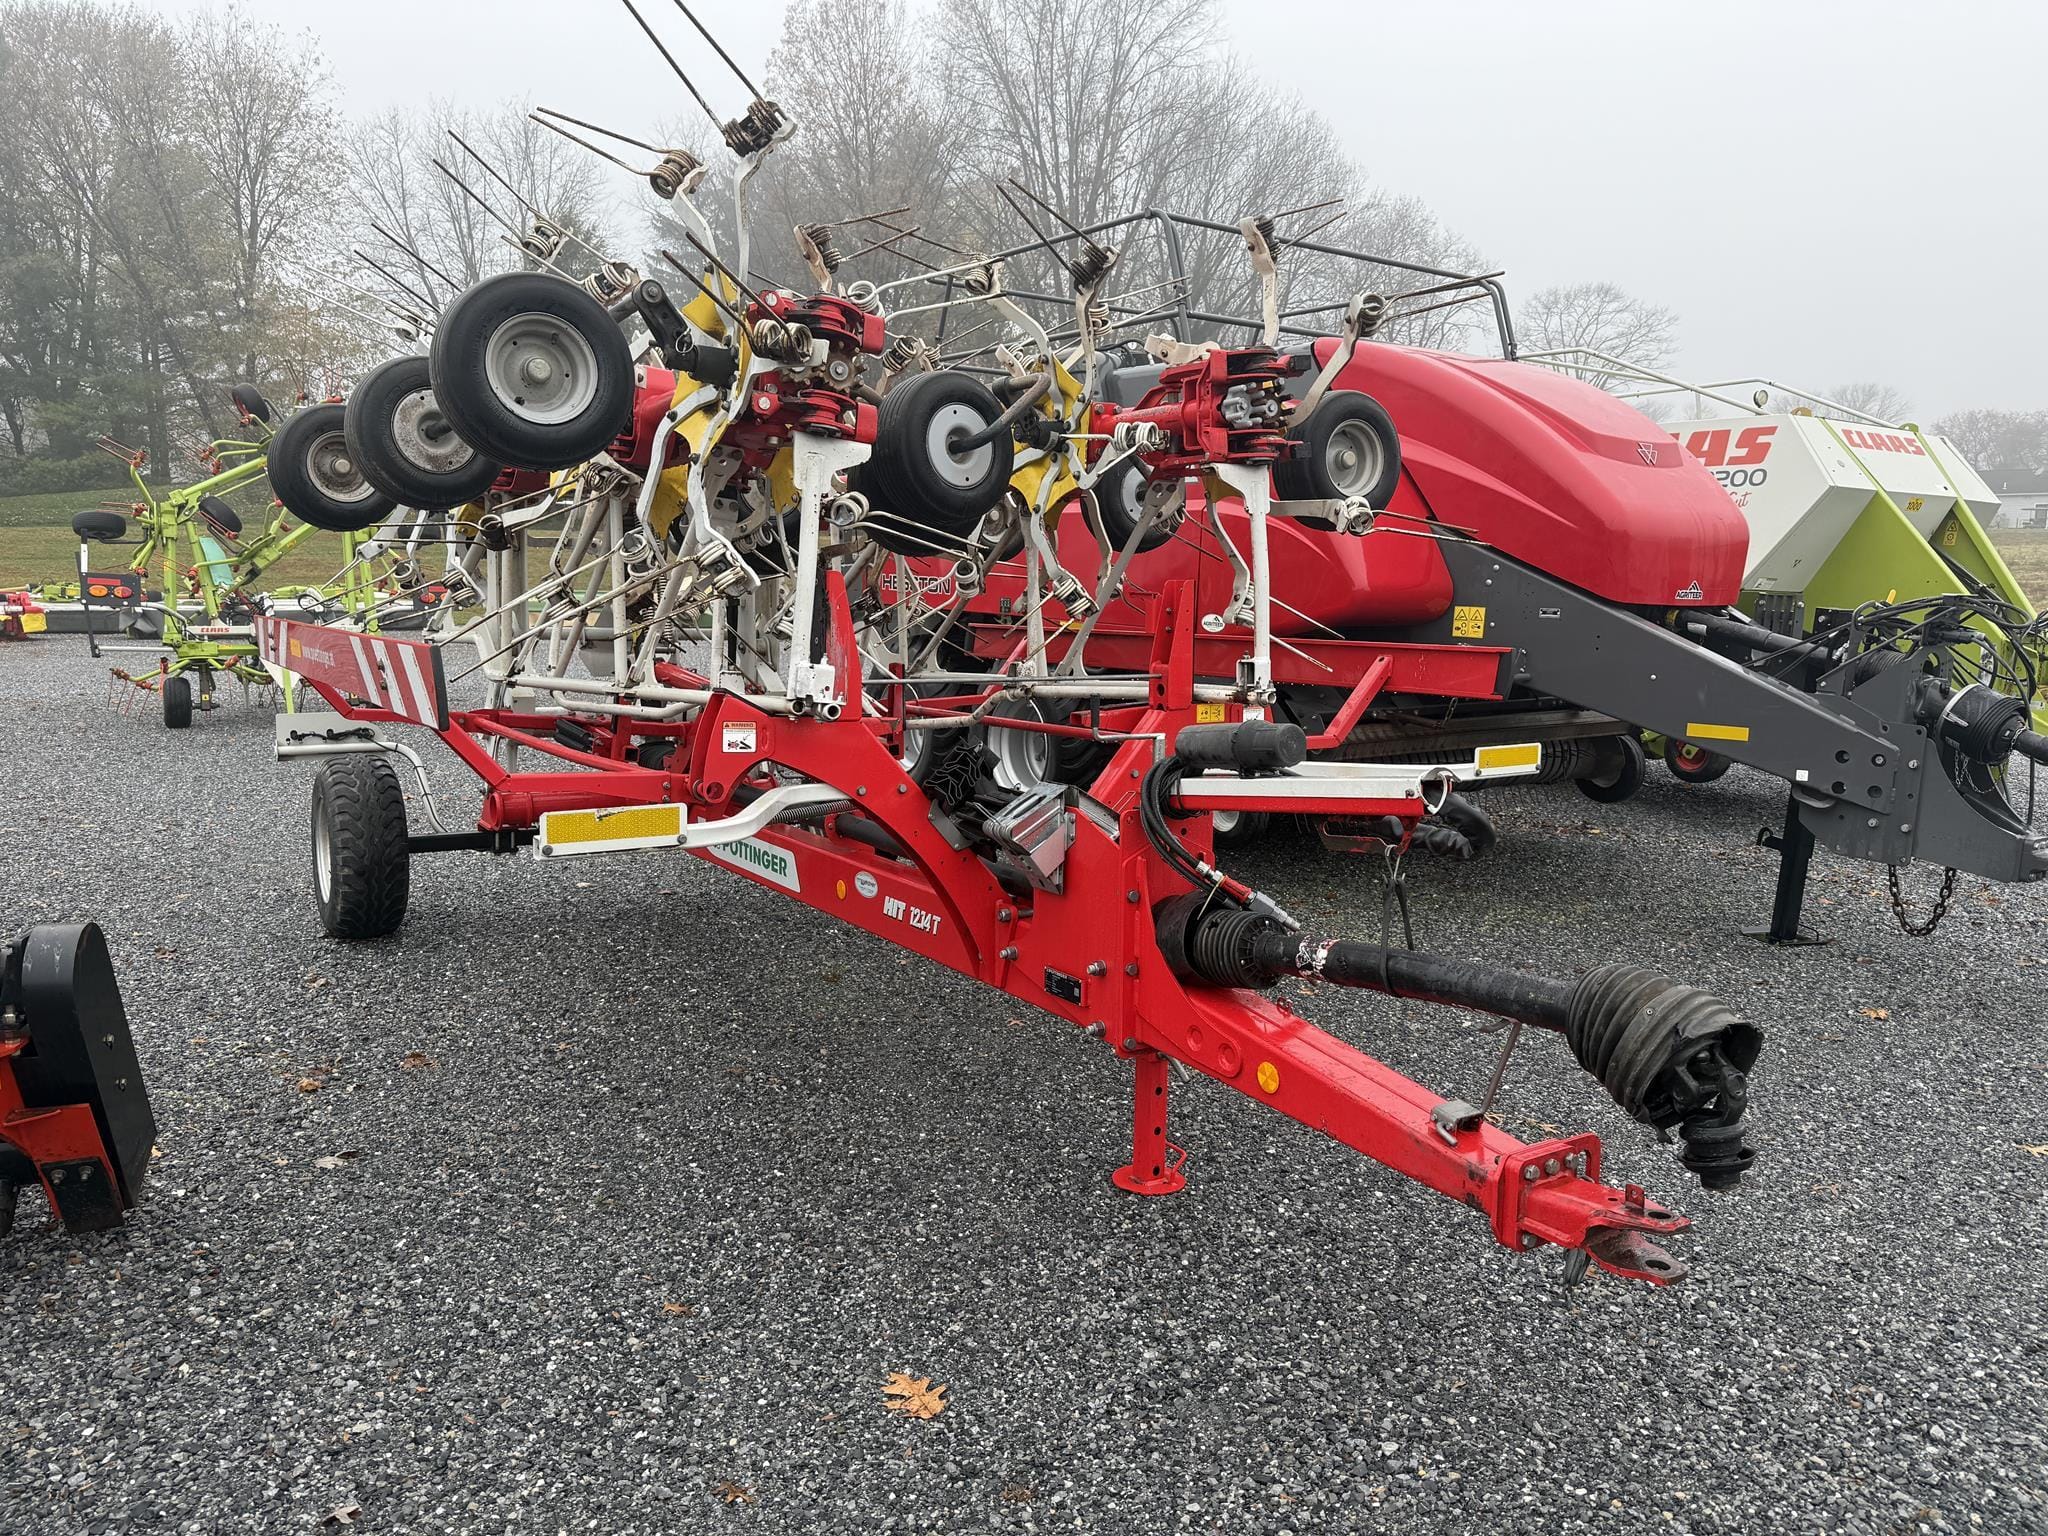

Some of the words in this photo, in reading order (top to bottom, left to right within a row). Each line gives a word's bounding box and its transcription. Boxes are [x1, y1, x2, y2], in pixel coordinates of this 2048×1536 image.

[1841, 428, 1926, 456] CLAAS
[883, 895, 907, 921] HIT
[932, 914, 941, 935] T
